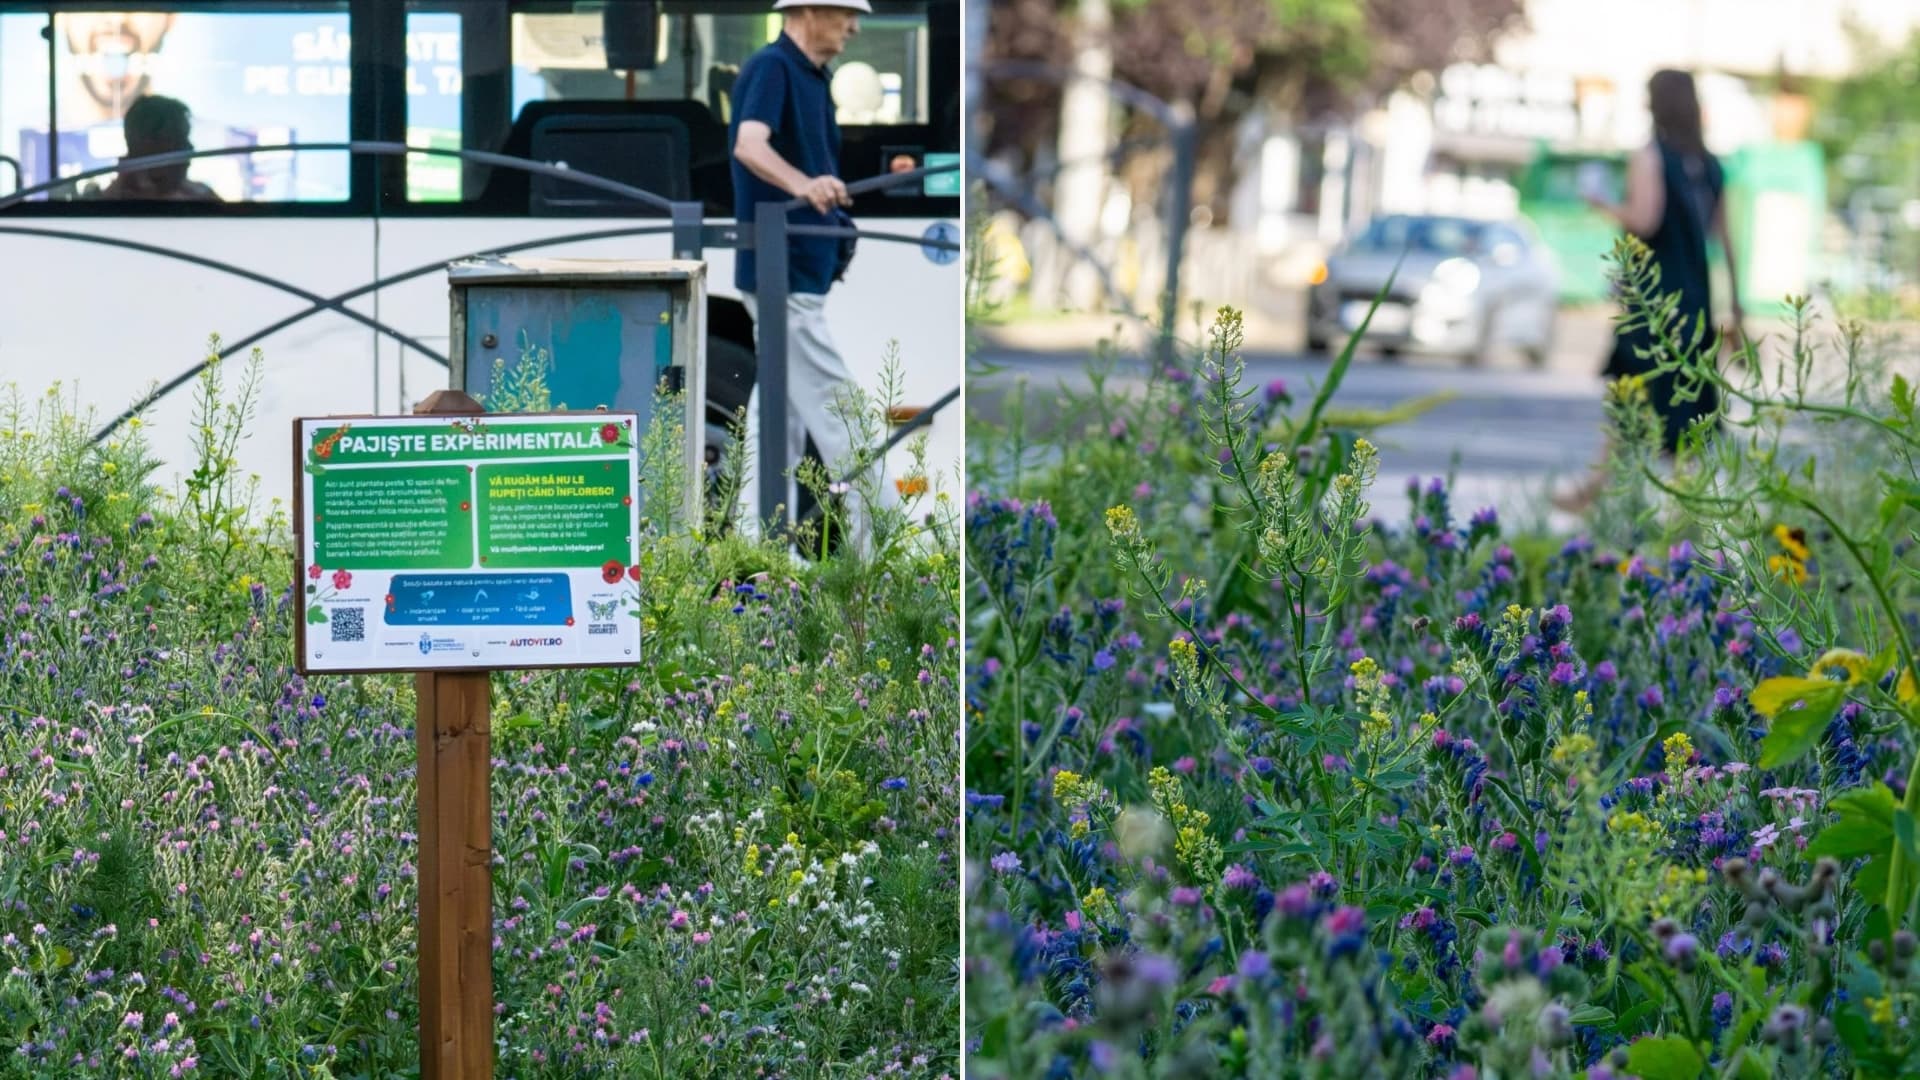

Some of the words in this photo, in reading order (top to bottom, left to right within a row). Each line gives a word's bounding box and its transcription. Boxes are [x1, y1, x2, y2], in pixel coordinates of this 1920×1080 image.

[339, 434, 426, 457] PAJIȘTE
[431, 427, 603, 452] EXPERIMENTALĂ
[356, 480, 384, 488] plantate
[385, 479, 404, 488] peste
[435, 478, 445, 486] de
[489, 475, 503, 486] VĂ
[504, 474, 540, 485] RUGĂM
[541, 474, 555, 485] SĂ
[556, 475, 571, 484] NU
[572, 475, 585, 484] LE
[354, 489, 363, 497] de
[489, 488, 525, 500] RUPEȚI
[527, 486, 555, 497] CÂND
[518, 512, 552, 521] important
[500, 545, 538, 554] mulțumim
[539, 545, 564, 553] pentru
[509, 637, 563, 646] AUTOVIT.RO
